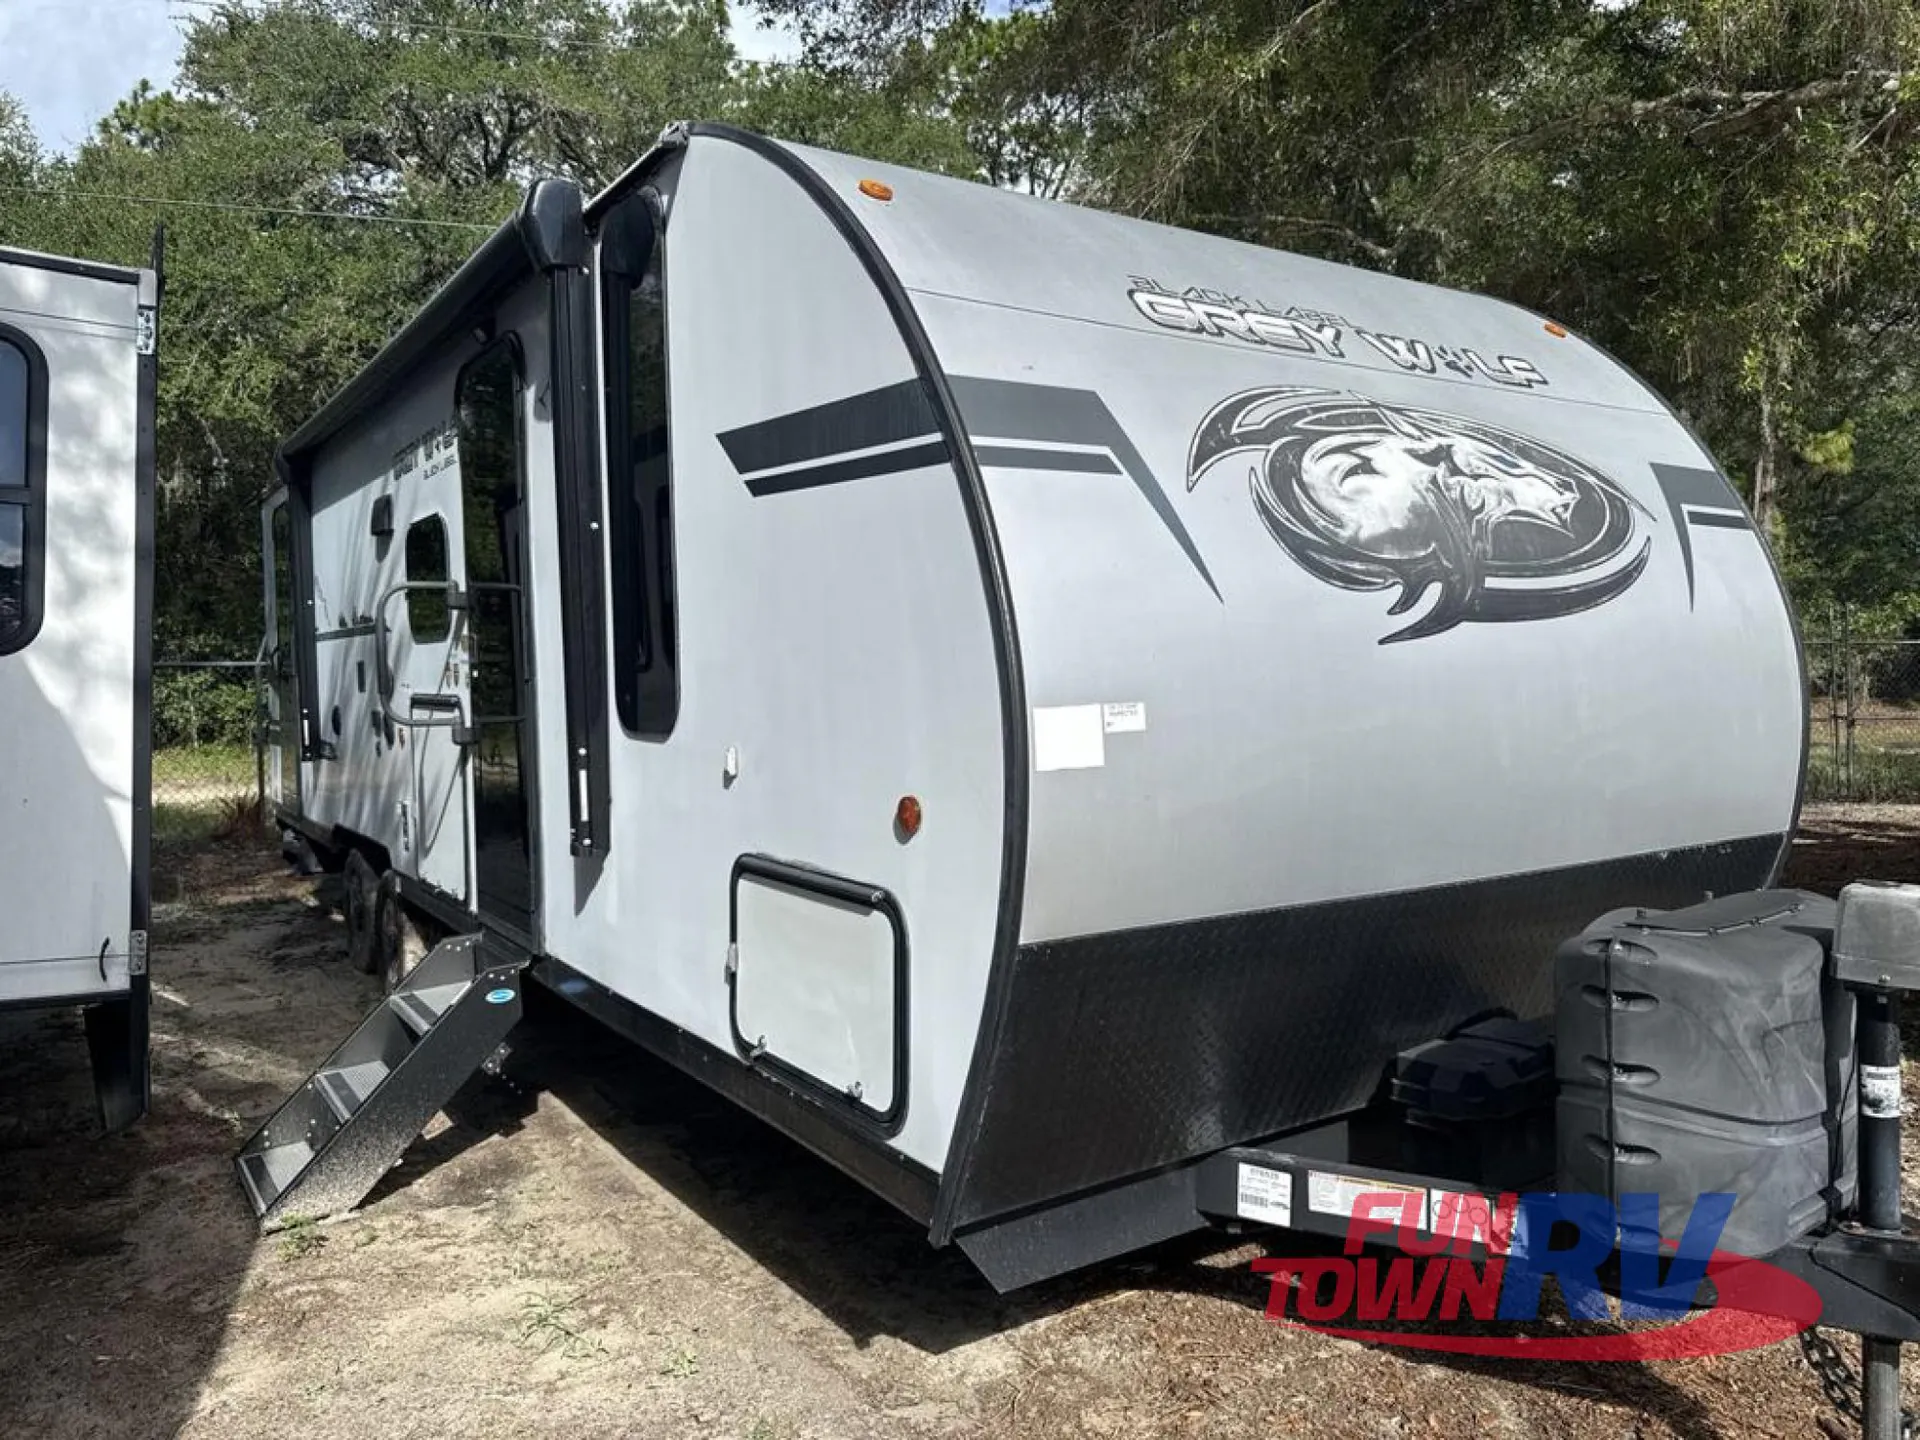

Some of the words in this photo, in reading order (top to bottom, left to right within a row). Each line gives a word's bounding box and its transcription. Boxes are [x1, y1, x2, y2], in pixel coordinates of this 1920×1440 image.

[1127, 275, 1251, 308] BLACK
[1255, 298, 1361, 330] LABEL
[1127, 288, 1346, 358] GREY
